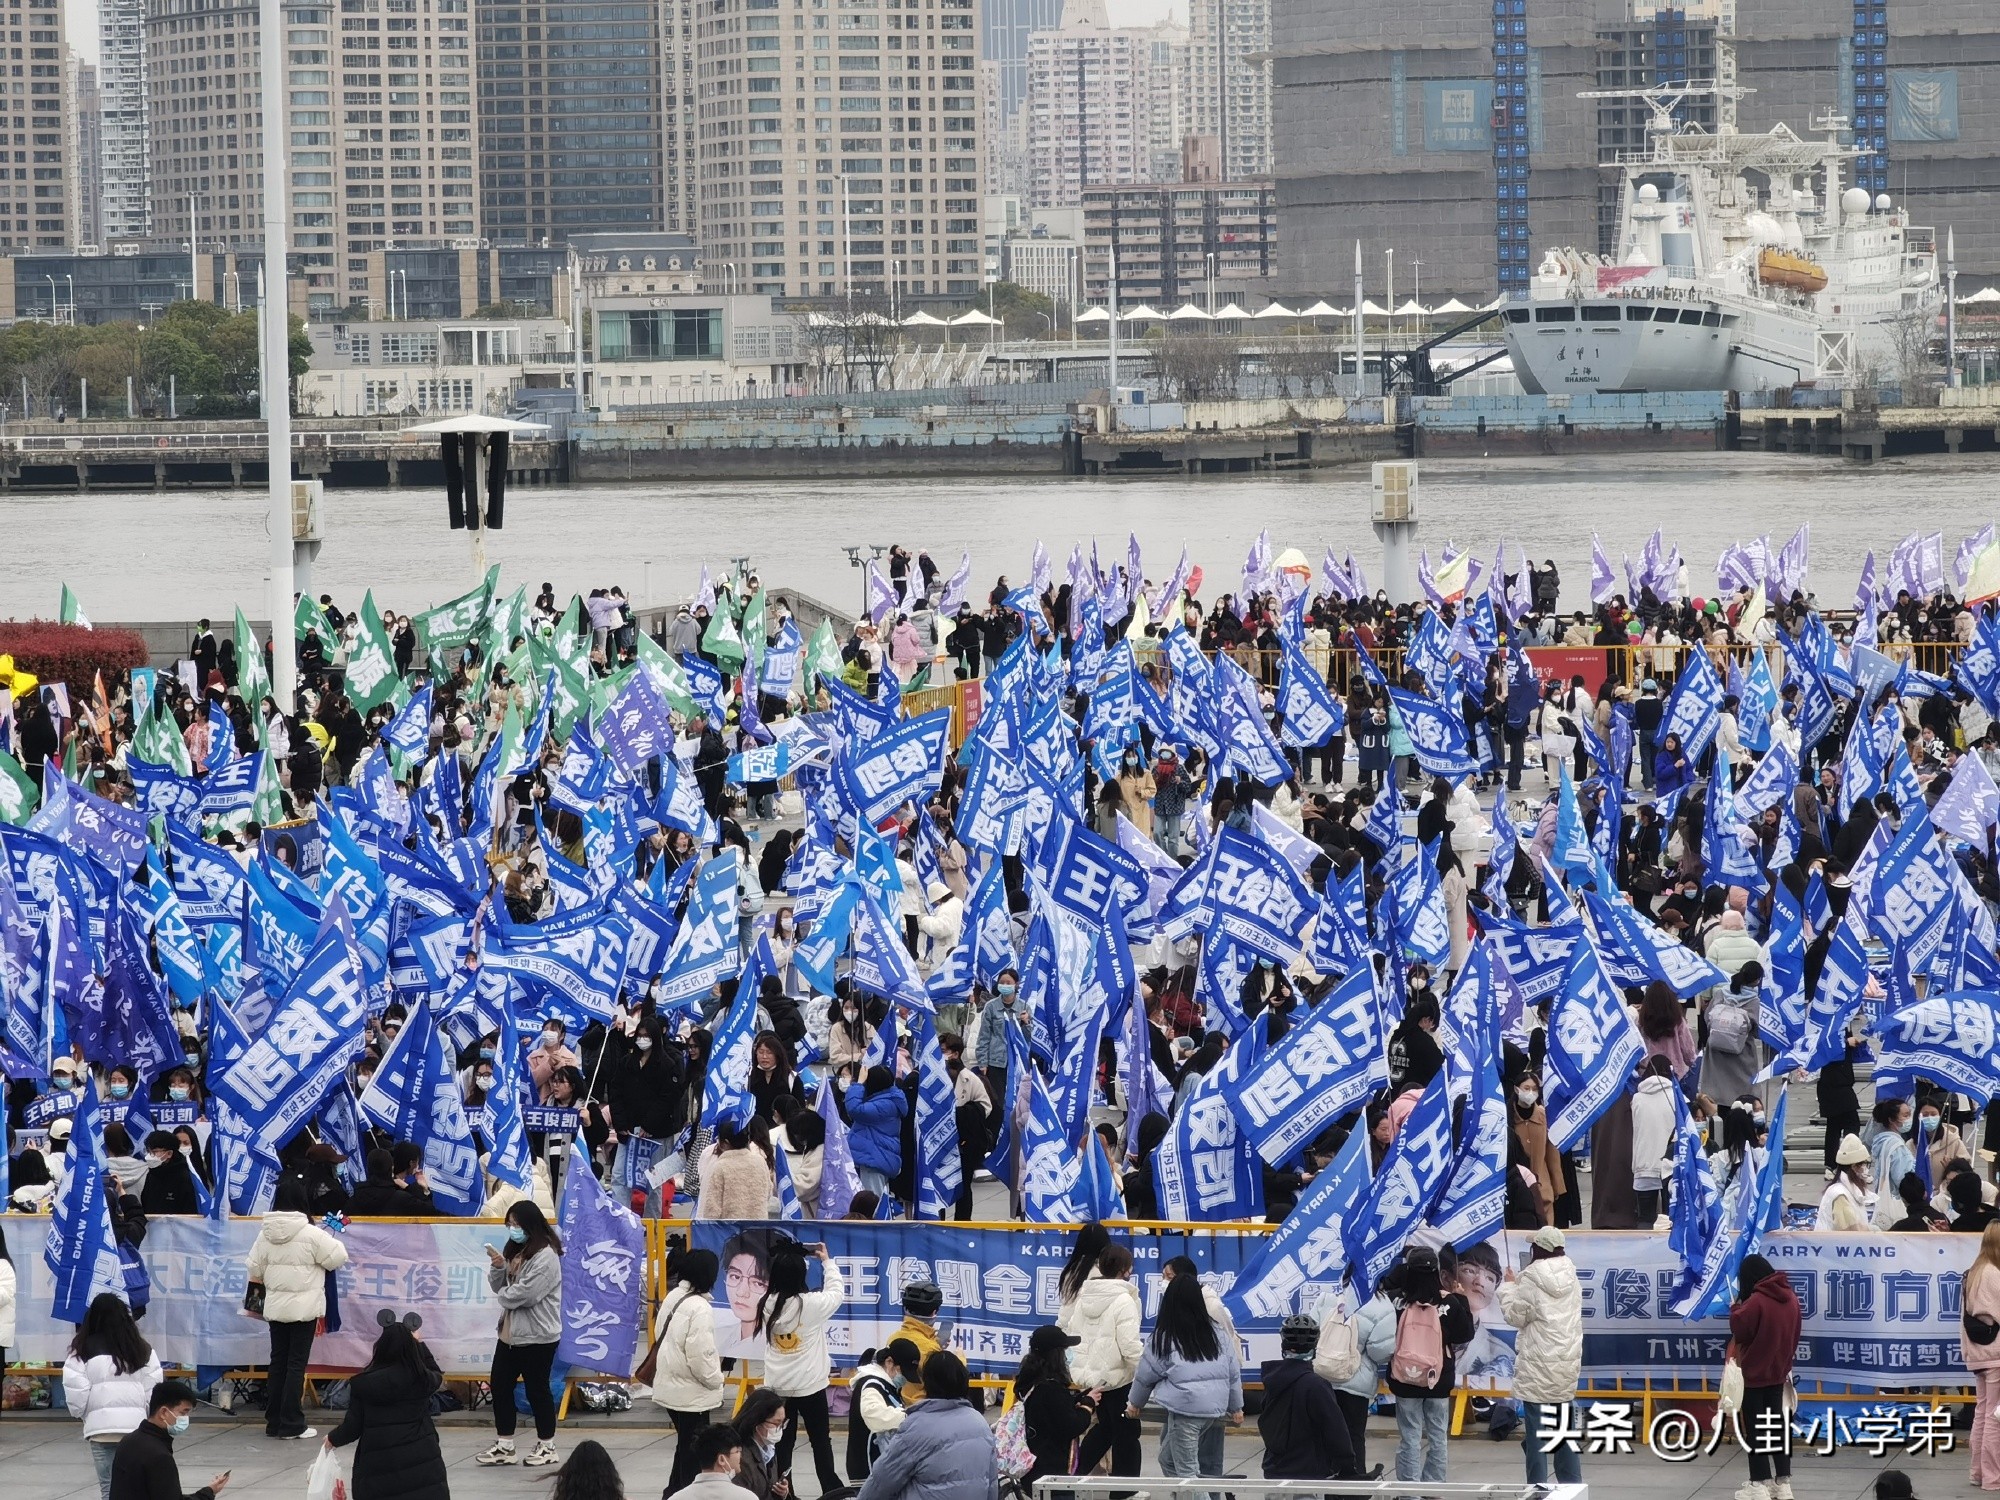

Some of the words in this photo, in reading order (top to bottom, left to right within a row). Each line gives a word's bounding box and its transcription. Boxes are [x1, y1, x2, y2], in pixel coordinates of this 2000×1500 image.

[1570, 367, 1592, 376] 上海
[1102, 922, 1118, 960] KARRY
[1111, 957, 1125, 990] WANG
[128, 952, 149, 986] KARRY
[146, 990, 167, 1021] WANG
[26, 1096, 73, 1124] 王俊凯
[1066, 1087, 1078, 1124] WANG
[526, 1112, 578, 1128] 王俊凯
[1133, 1246, 1160, 1259] NG
[1759, 1245, 1823, 1258] ARRY
[1836, 1246, 1897, 1258] WANG
